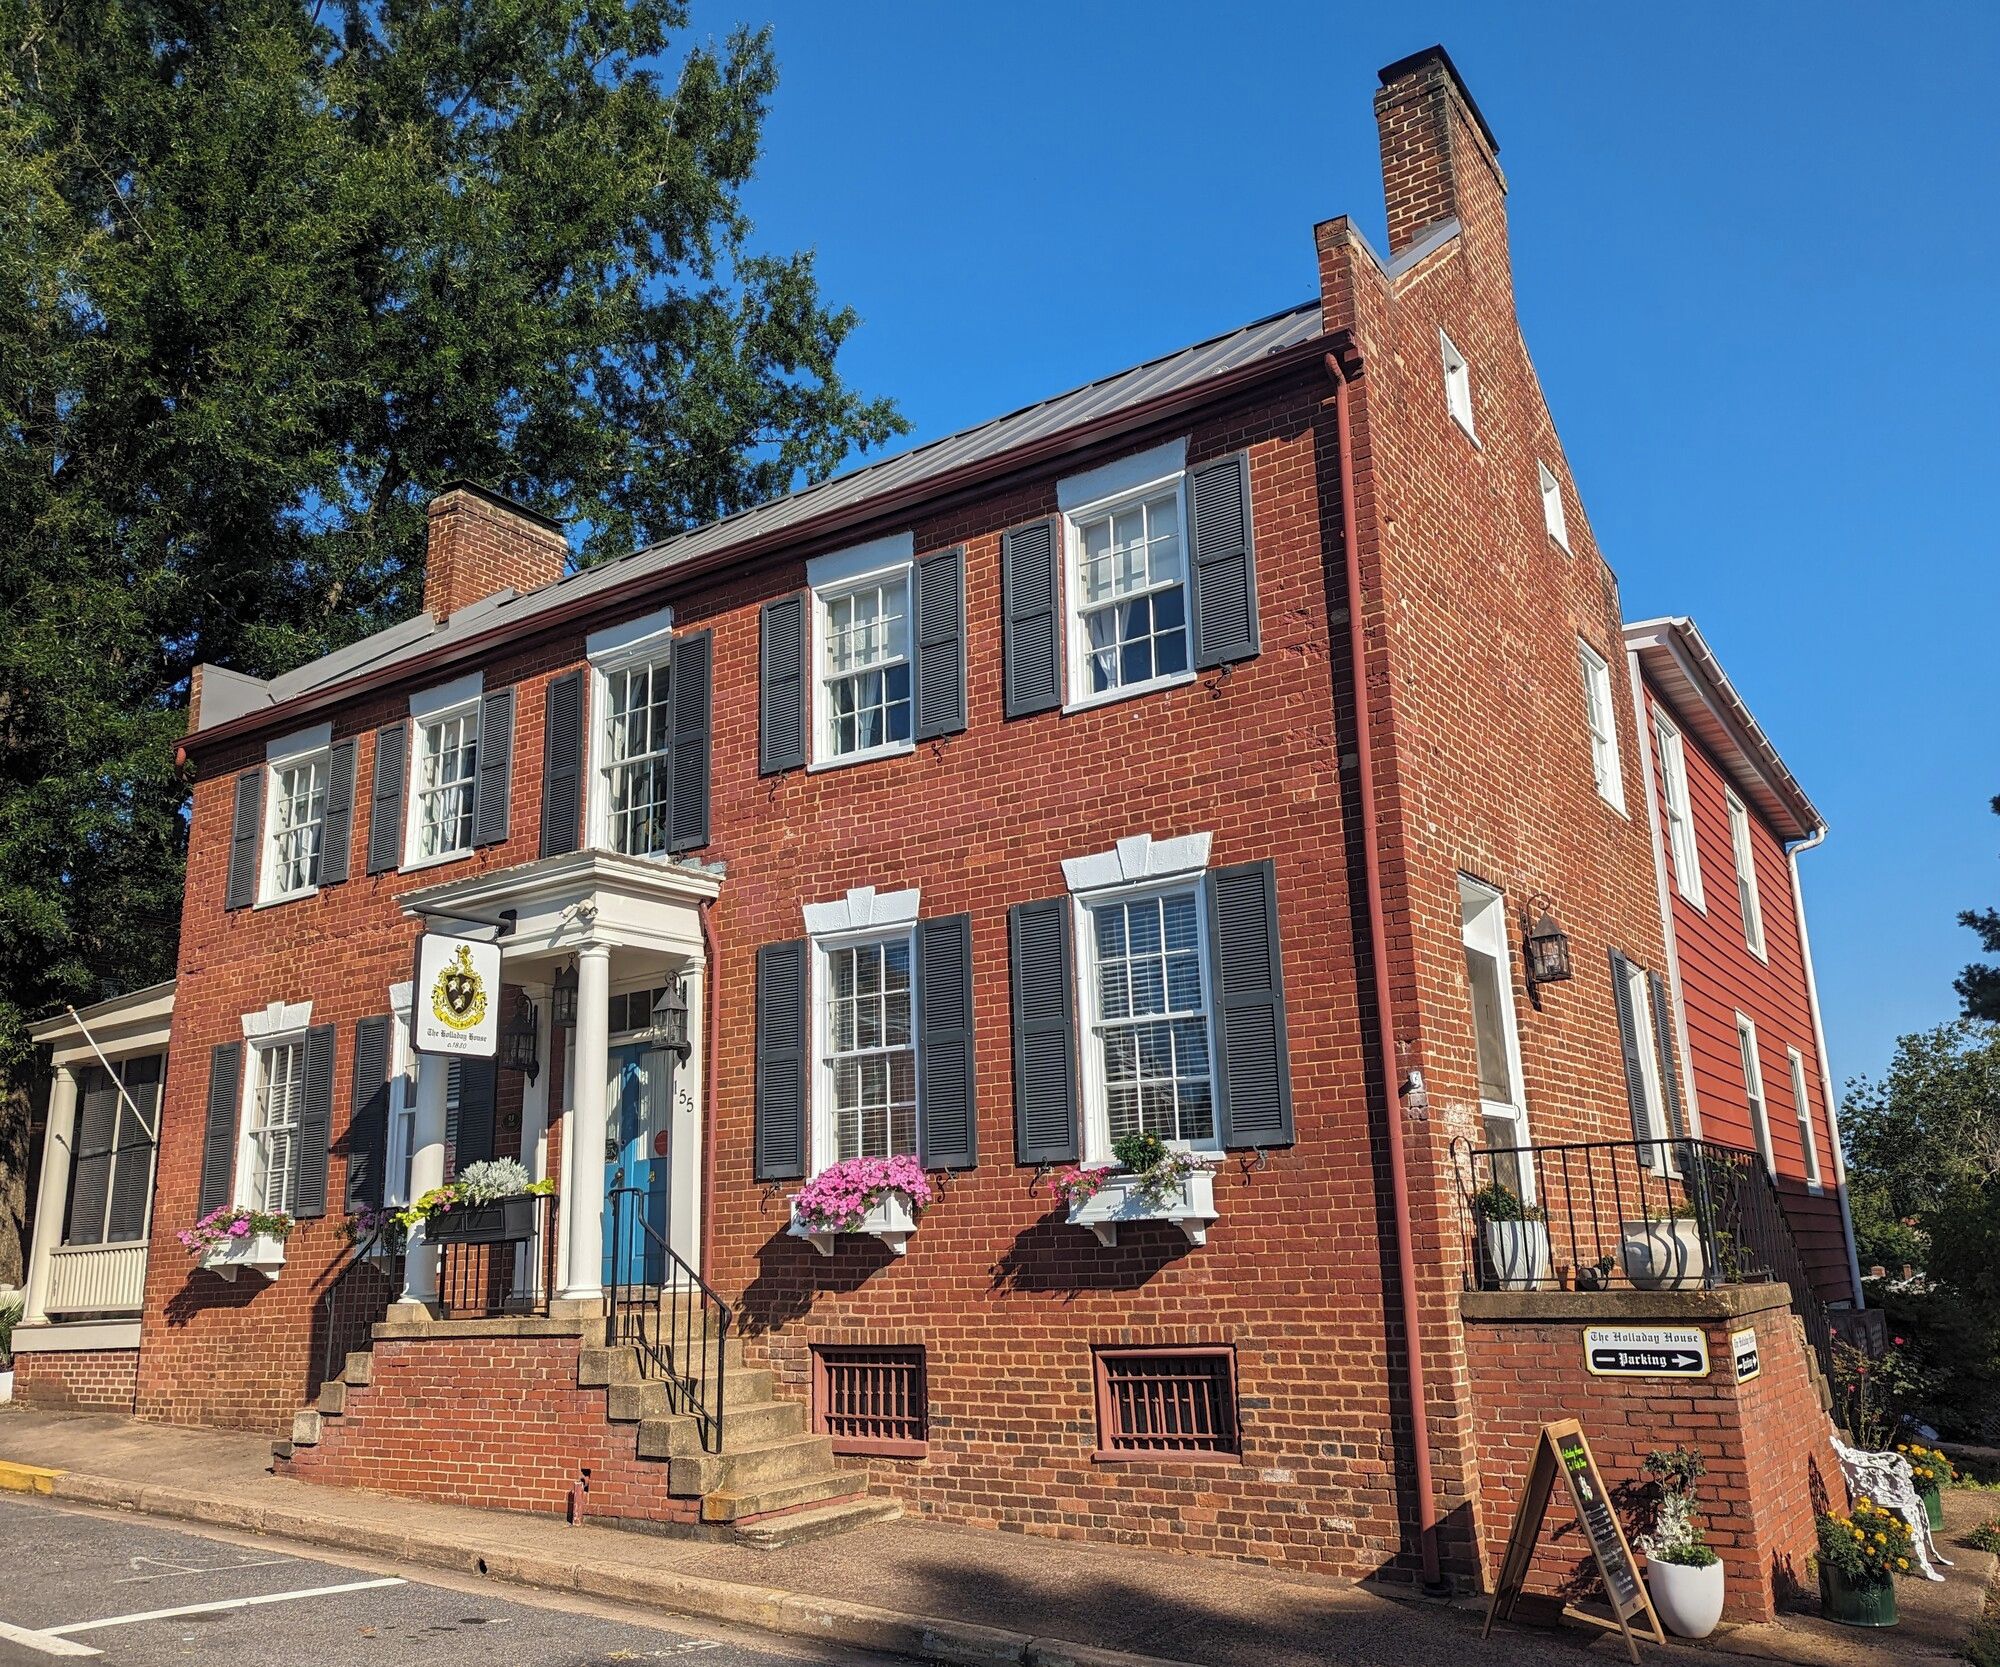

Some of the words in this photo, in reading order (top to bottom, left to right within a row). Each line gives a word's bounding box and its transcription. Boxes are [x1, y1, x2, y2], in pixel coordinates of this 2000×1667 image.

[427, 1028, 439, 1038] The
[440, 1029, 467, 1041] Holladay
[468, 1032, 488, 1043] House
[674, 1080, 694, 1113] 155
[1590, 1331, 1609, 1343] The
[1613, 1331, 1660, 1344] Holladay
[1663, 1332, 1699, 1343] House
[1618, 1352, 1668, 1367] Parking
